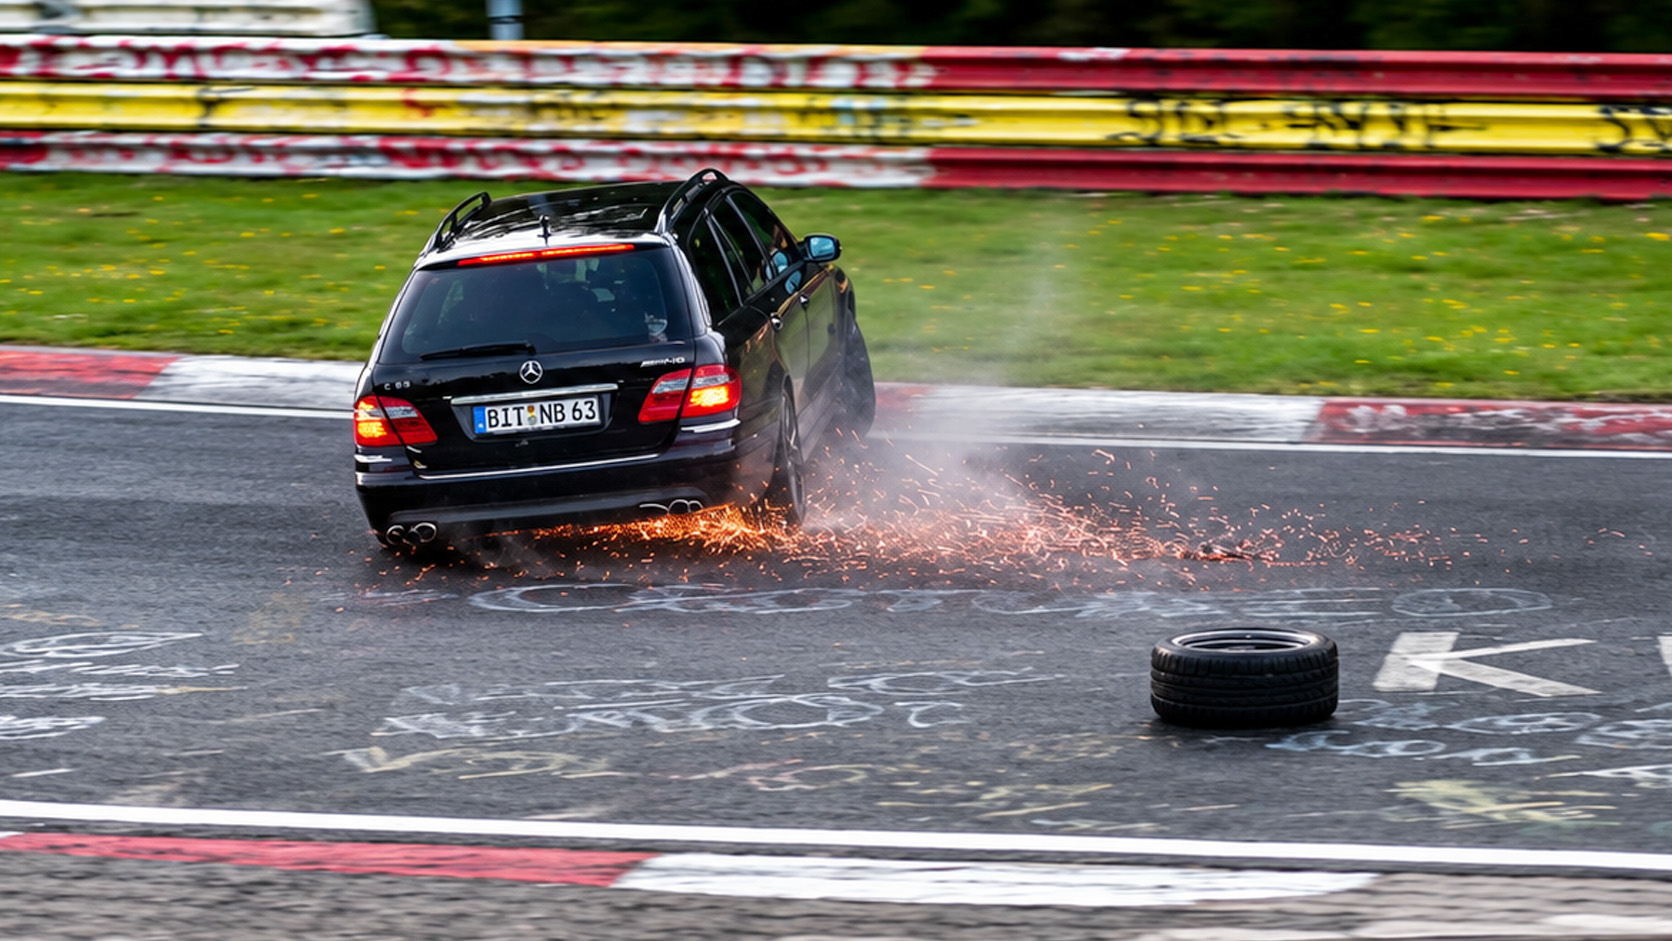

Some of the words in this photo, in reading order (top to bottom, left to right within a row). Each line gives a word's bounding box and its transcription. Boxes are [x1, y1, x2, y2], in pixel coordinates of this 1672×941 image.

[487, 406, 525, 429] BIT
[540, 403, 566, 424] NB
[572, 400, 597, 421] 63
[1373, 631, 1672, 698] K
